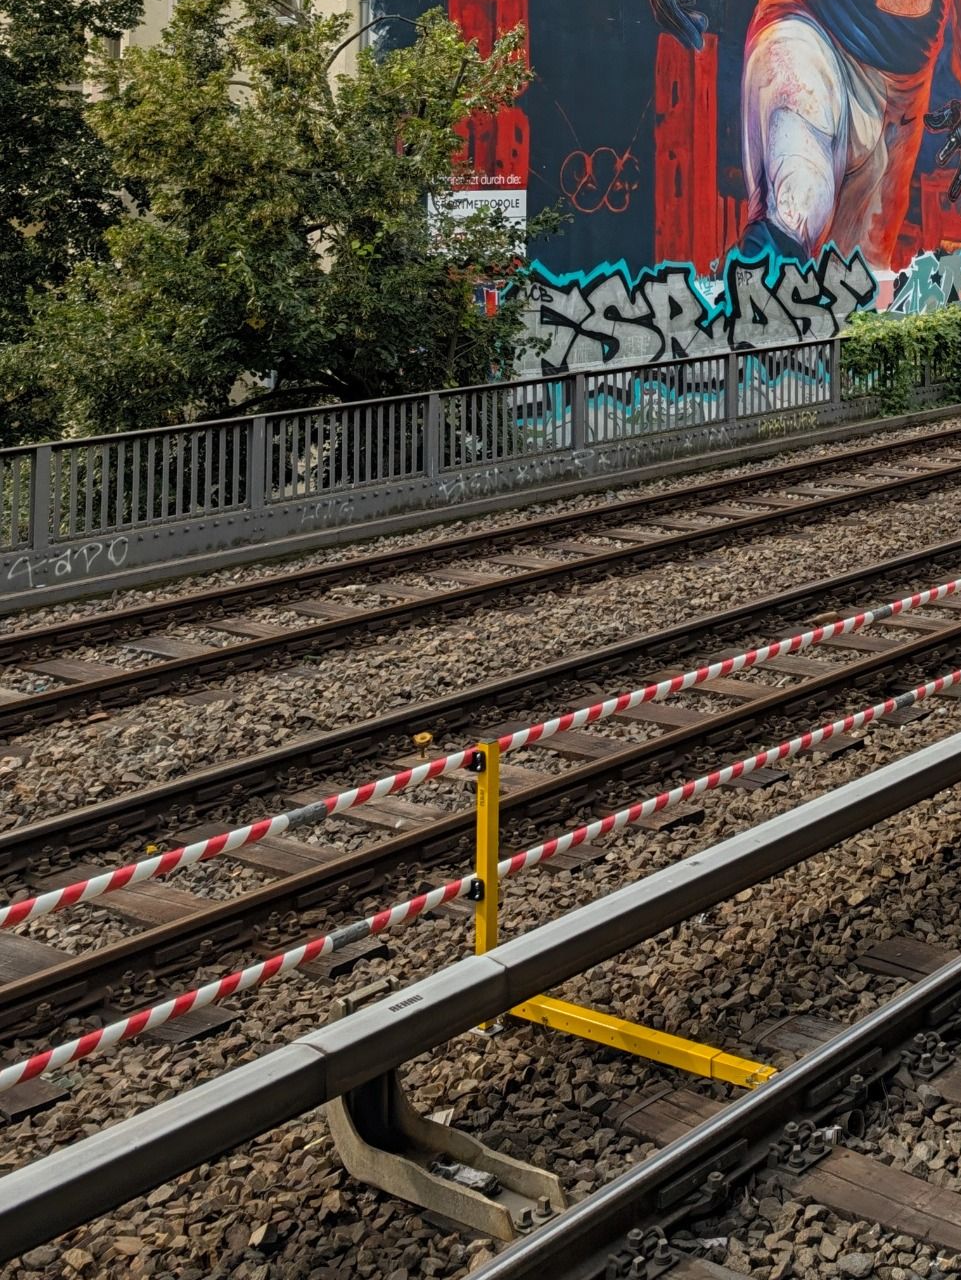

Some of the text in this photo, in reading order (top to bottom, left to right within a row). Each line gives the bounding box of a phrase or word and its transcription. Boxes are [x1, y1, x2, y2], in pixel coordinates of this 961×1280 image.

[480, 175, 506, 186] durch
[506, 175, 522, 185] die:
[389, 995, 424, 1012] REHAU
